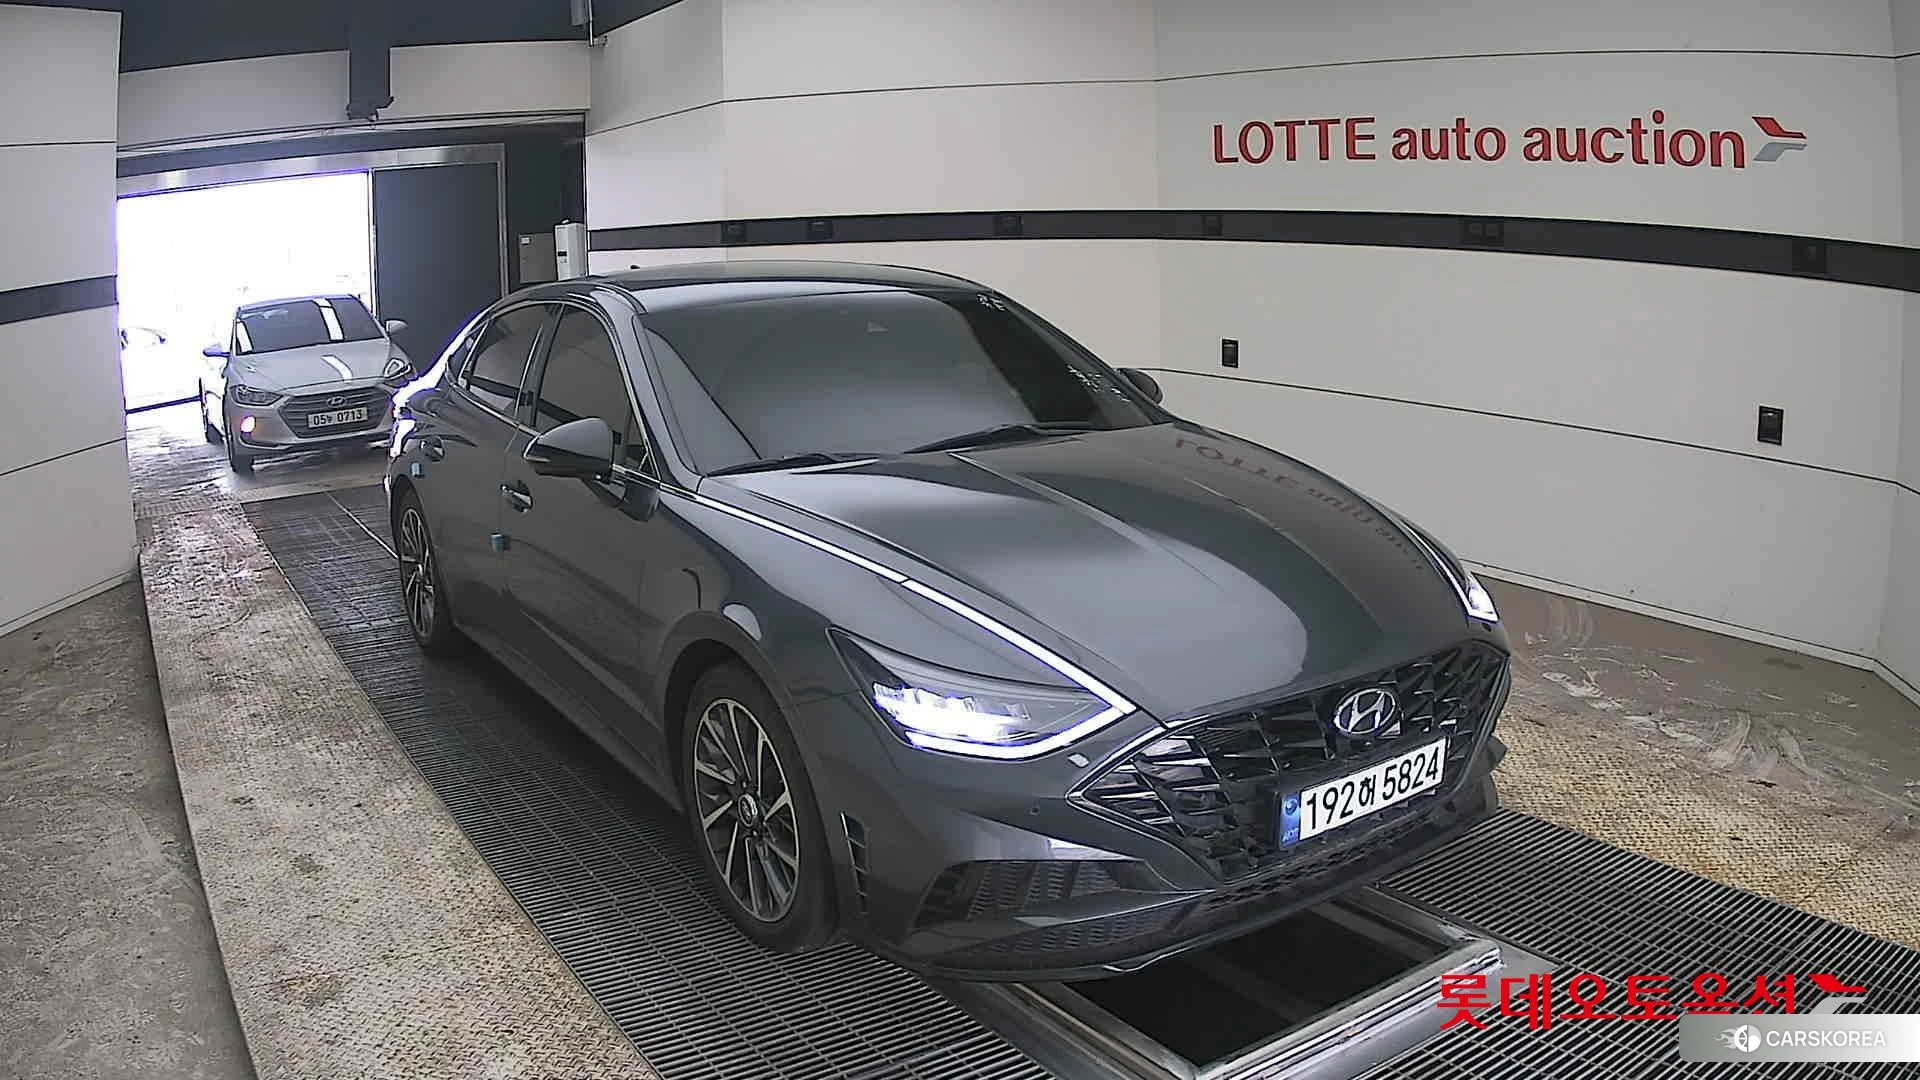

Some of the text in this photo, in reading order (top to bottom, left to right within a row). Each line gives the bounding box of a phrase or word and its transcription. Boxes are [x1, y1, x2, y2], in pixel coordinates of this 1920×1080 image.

[1213, 110, 1745, 168] LOTTE auto auction
[336, 409, 362, 422] 0713
[1306, 746, 1439, 830] 192허 5824
